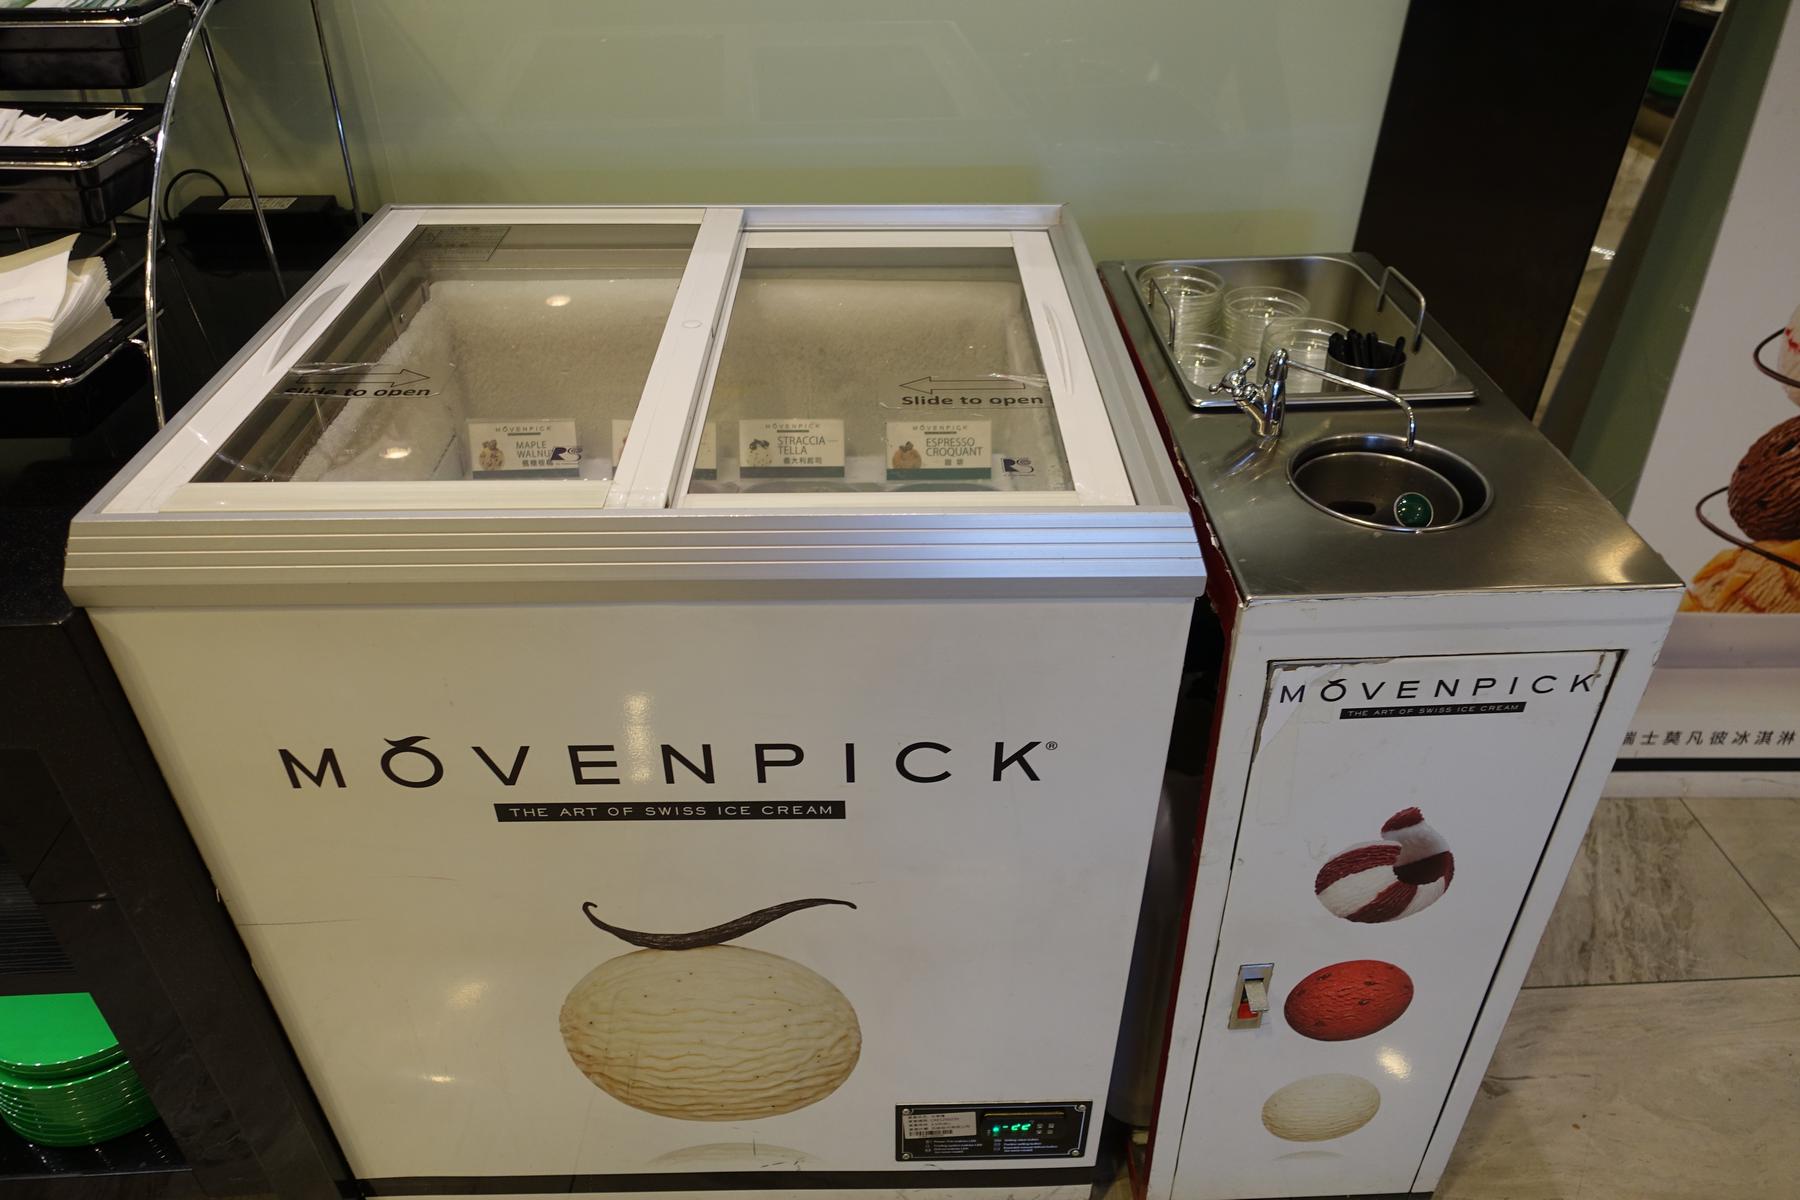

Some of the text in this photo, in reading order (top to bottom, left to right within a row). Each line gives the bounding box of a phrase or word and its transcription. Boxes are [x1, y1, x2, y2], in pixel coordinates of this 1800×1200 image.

[344, 388, 367, 397] to
[374, 388, 430, 397] open
[902, 395, 1044, 407] Slide to open
[516, 441, 548, 449] MAPLE
[776, 436, 826, 445] STRACCIA
[926, 437, 976, 447] ESPRESSO
[518, 449, 555, 459] WALNU
[777, 446, 808, 455] TELLA
[926, 447, 984, 457] CROQUANT
[1480, 704, 1519, 712] CREAM
[509, 805, 832, 817] THE ART OF SWISS ICE CREAM
